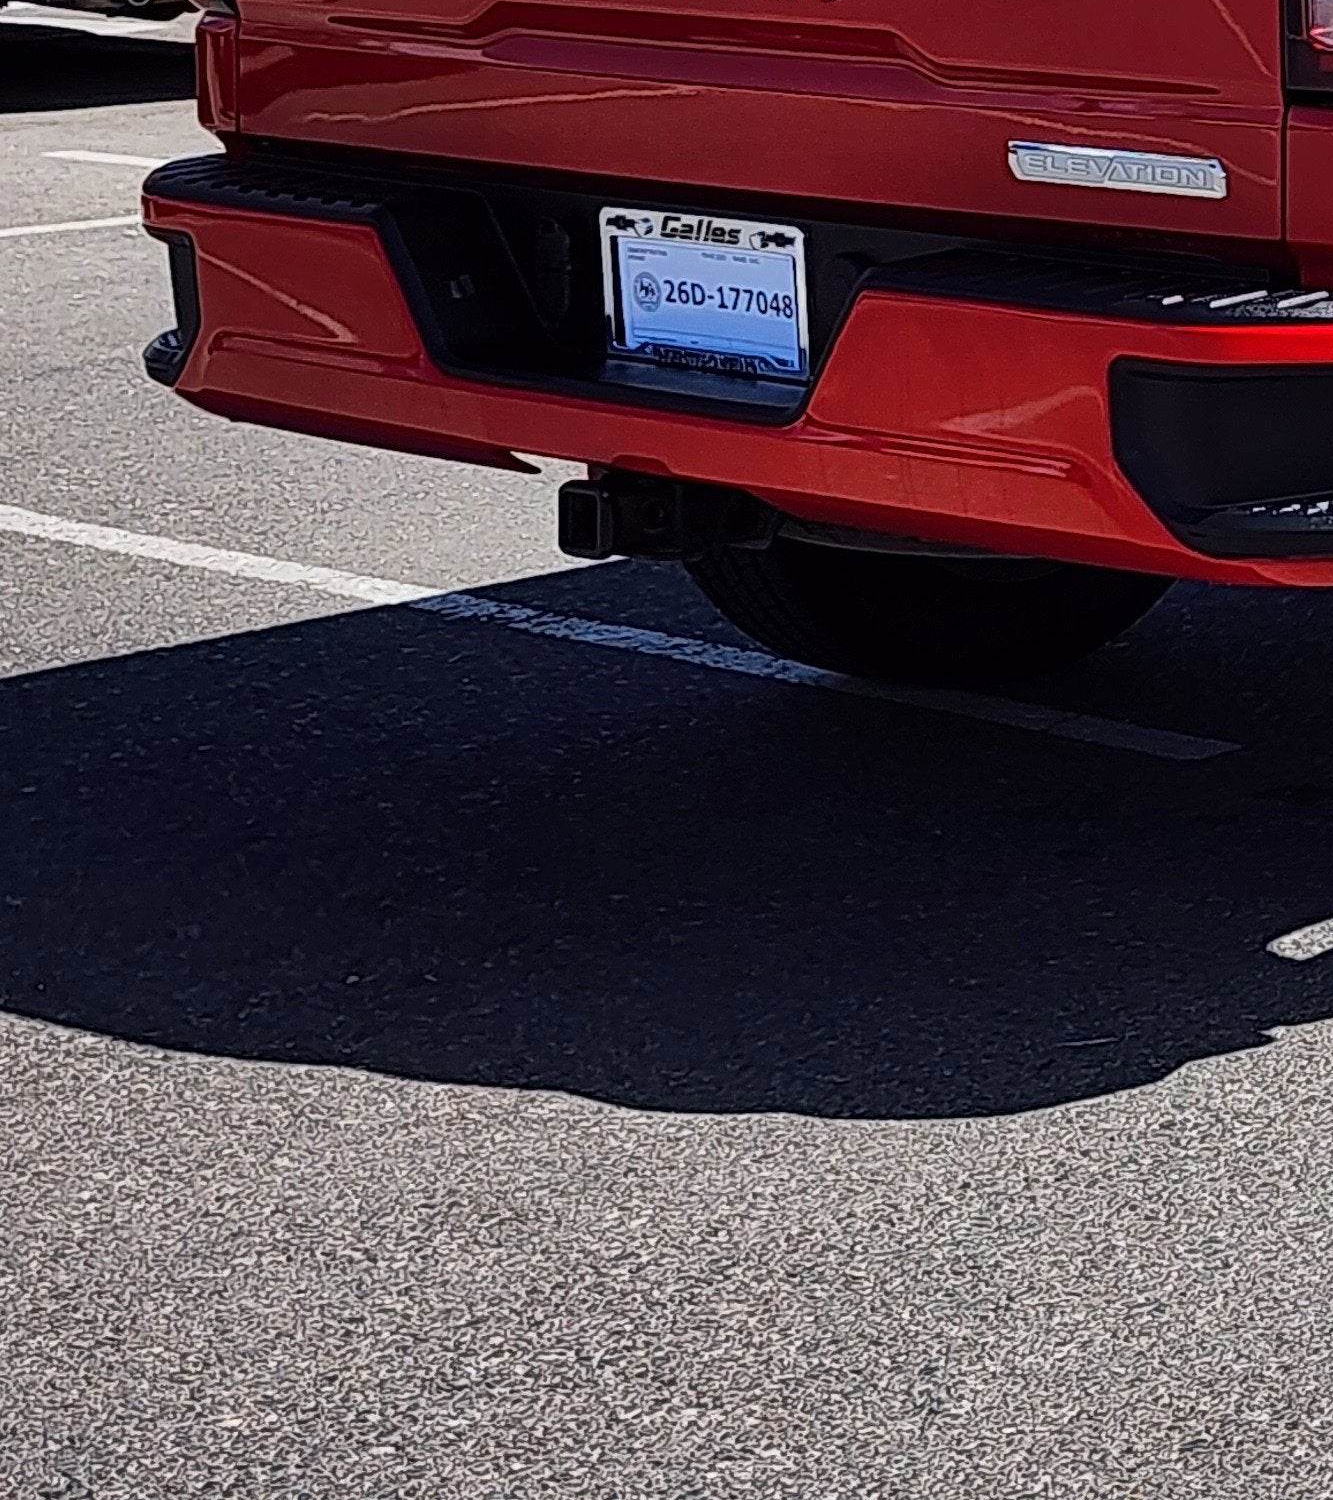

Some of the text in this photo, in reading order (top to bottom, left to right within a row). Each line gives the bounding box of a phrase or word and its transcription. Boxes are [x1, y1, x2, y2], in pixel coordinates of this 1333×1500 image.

[1024, 153, 1209, 188] ELEVATION
[659, 215, 743, 246] Galles
[662, 279, 794, 319] 26D-177048
